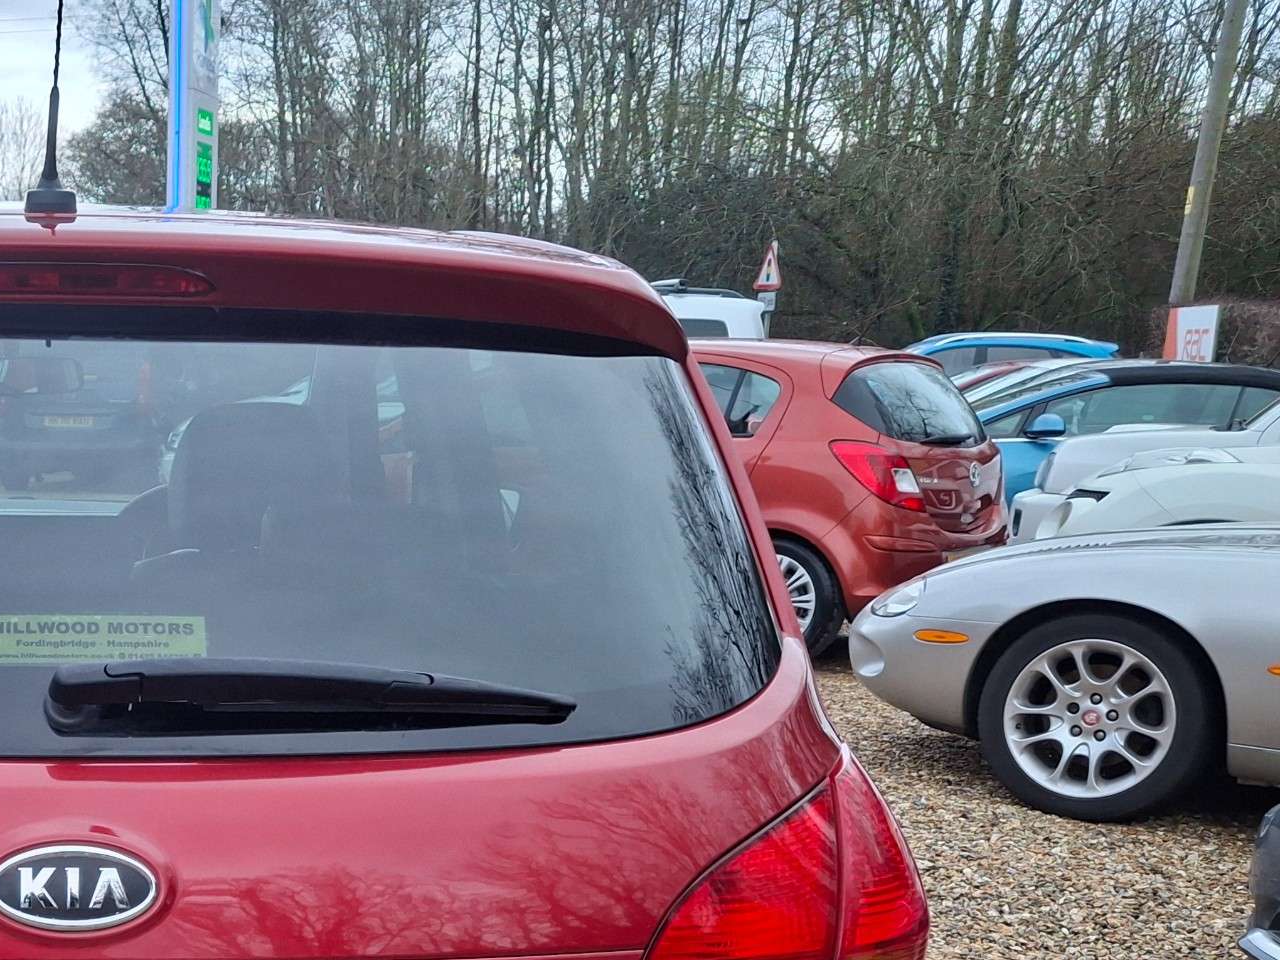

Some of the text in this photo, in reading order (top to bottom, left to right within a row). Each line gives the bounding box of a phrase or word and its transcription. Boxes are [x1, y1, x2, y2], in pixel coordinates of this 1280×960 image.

[107, 621, 195, 636] MOTORS
[16, 638, 171, 650] Fordingbridge Hampshire
[17, 866, 130, 910] KIA
